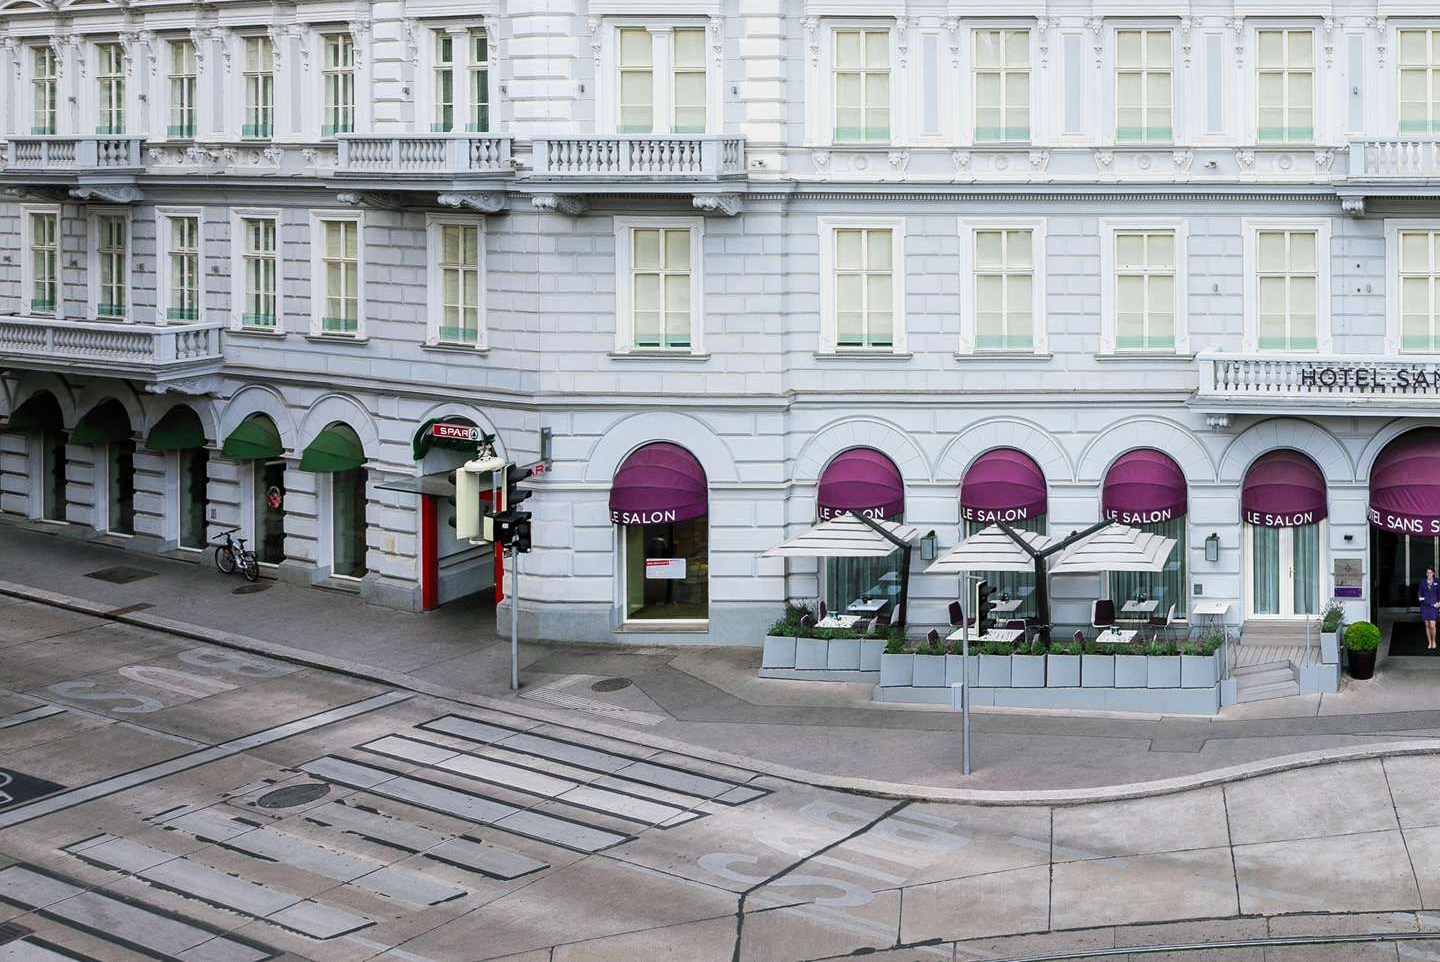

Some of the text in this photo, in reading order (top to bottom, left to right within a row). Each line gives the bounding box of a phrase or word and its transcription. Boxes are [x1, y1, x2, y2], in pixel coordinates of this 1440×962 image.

[1301, 368, 1385, 387] HOTEL
[440, 426, 469, 437] SPAR
[622, 510, 676, 524] SALON
[962, 507, 1027, 522] LE SALON
[1106, 508, 1171, 523] LE SALON
[1247, 511, 1313, 526] LE SALON
[1387, 515, 1423, 533] SANS
